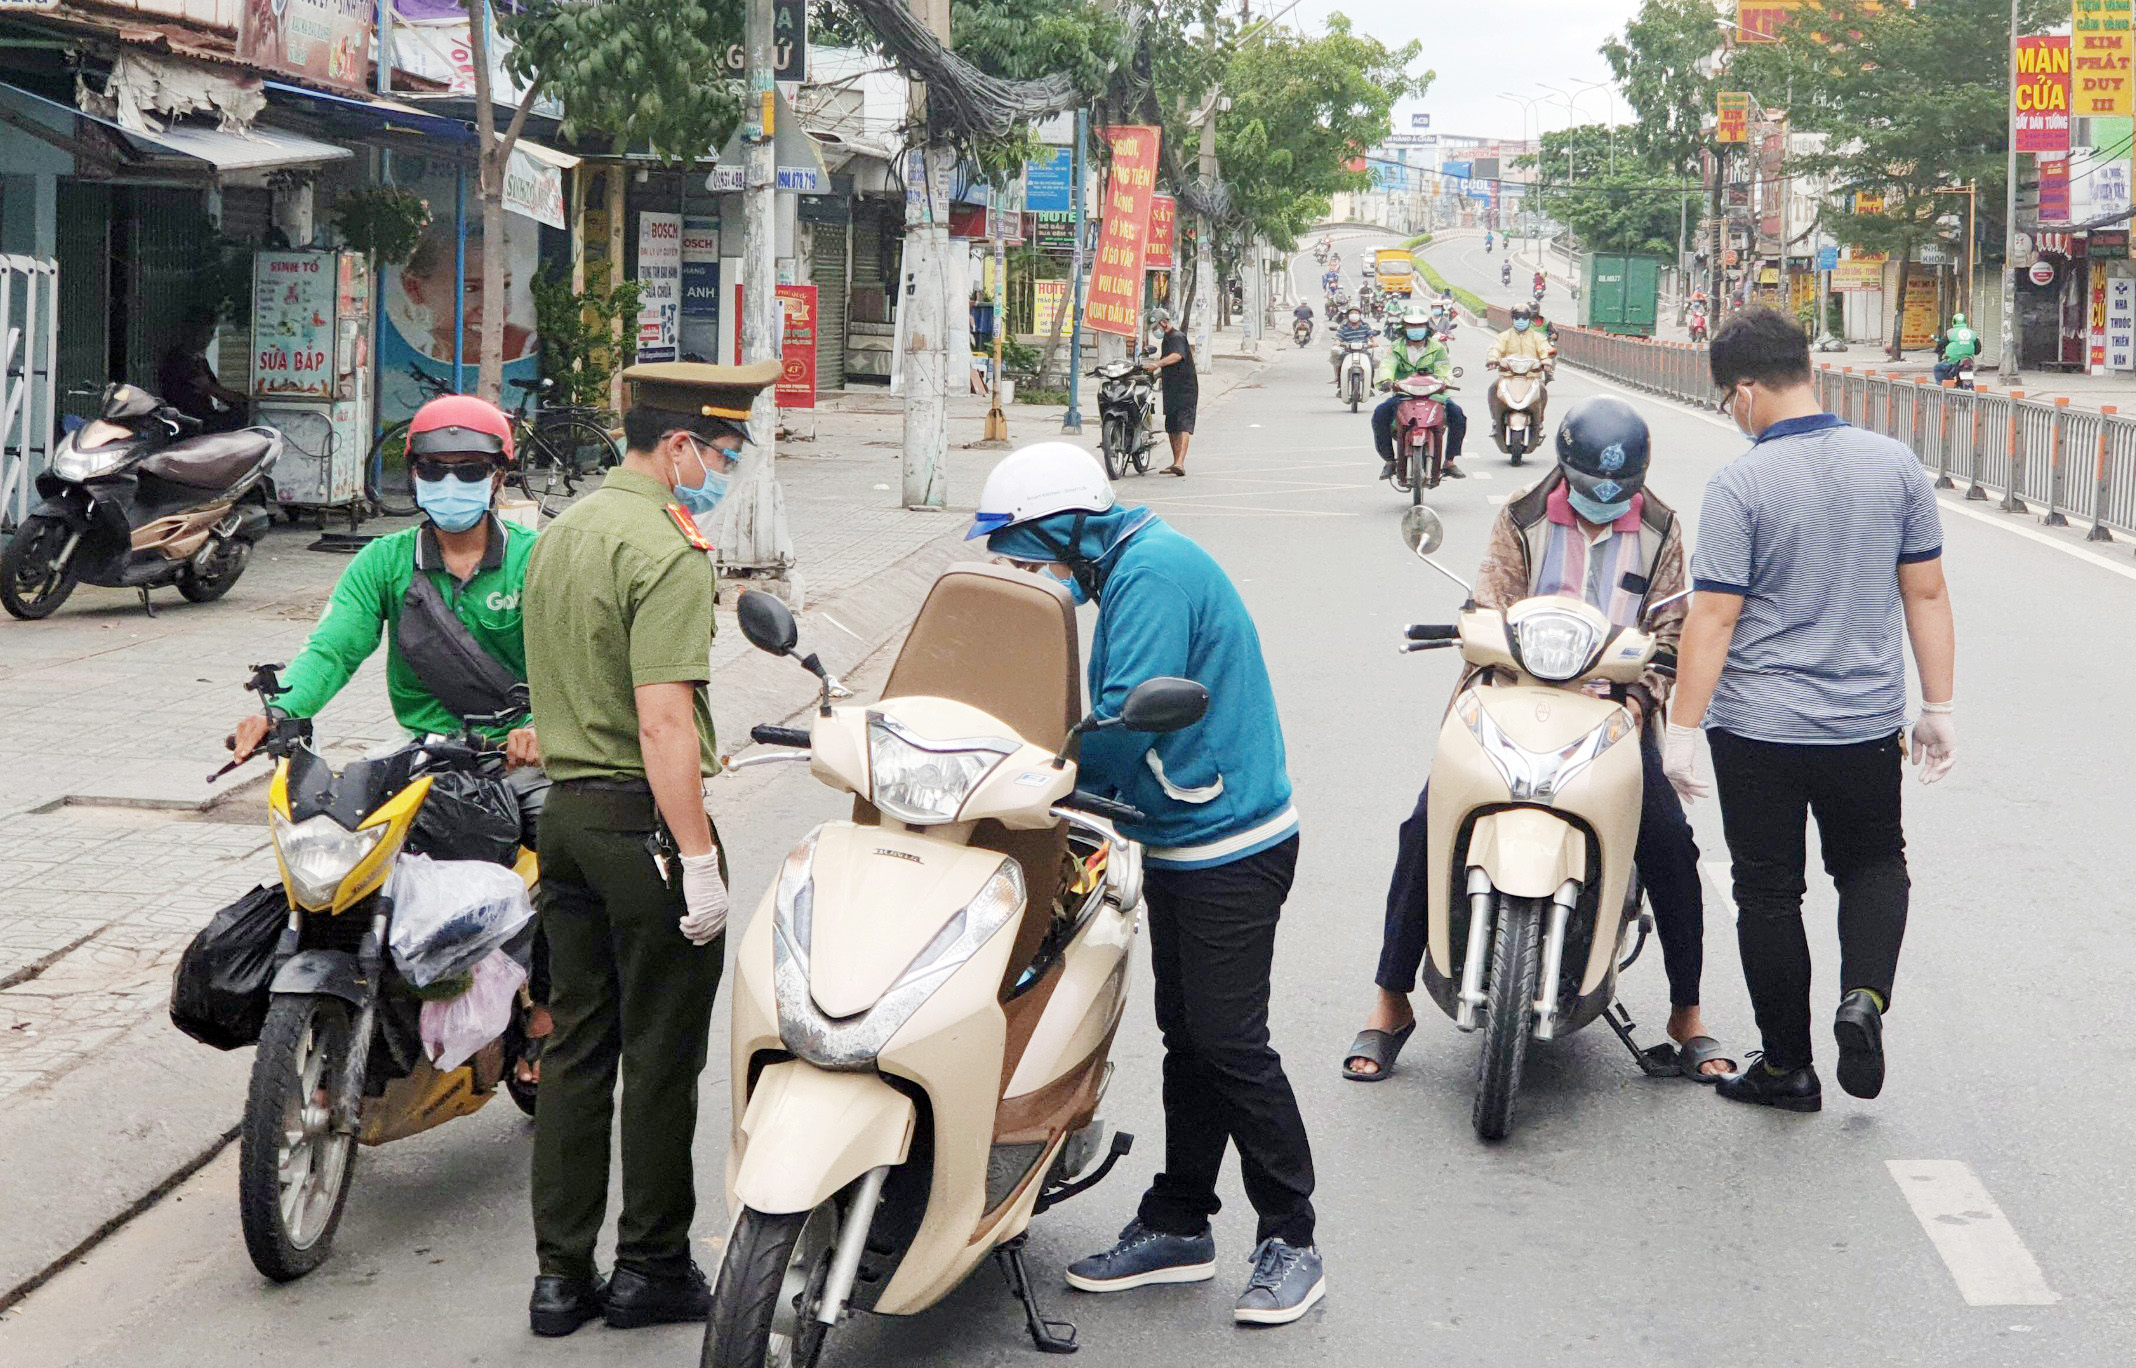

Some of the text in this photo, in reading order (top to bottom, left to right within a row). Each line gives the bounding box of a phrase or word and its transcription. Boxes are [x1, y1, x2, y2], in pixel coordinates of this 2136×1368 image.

[2083, 36, 2123, 49] KIM
[2016, 40, 2069, 73] MÀN
[2076, 52, 2130, 69] PHÁT
[2083, 78, 2125, 90] DUY
[2016, 75, 2066, 111] CỬA
[2092, 98, 2115, 111] III
[1412, 116, 1429, 125] ACB
[2029, 113, 2044, 130] DÁN
[2045, 112, 2068, 130] TƯỜNG
[1038, 211, 1077, 222] HOTE
[651, 222, 678, 239] BOSCH
[682, 239, 713, 249] OSCH
[270, 256, 321, 273] SINH TỐ
[1109, 245, 1120, 265] GÒ
[1120, 246, 1135, 268] VẤP
[687, 286, 716, 298] ANH
[1038, 283, 1067, 294] HOTE
[1098, 273, 1134, 297] VUI LÒNG
[1088, 300, 1136, 326] QUAY ĐẦU XE
[294, 338, 325, 372] BẮP
